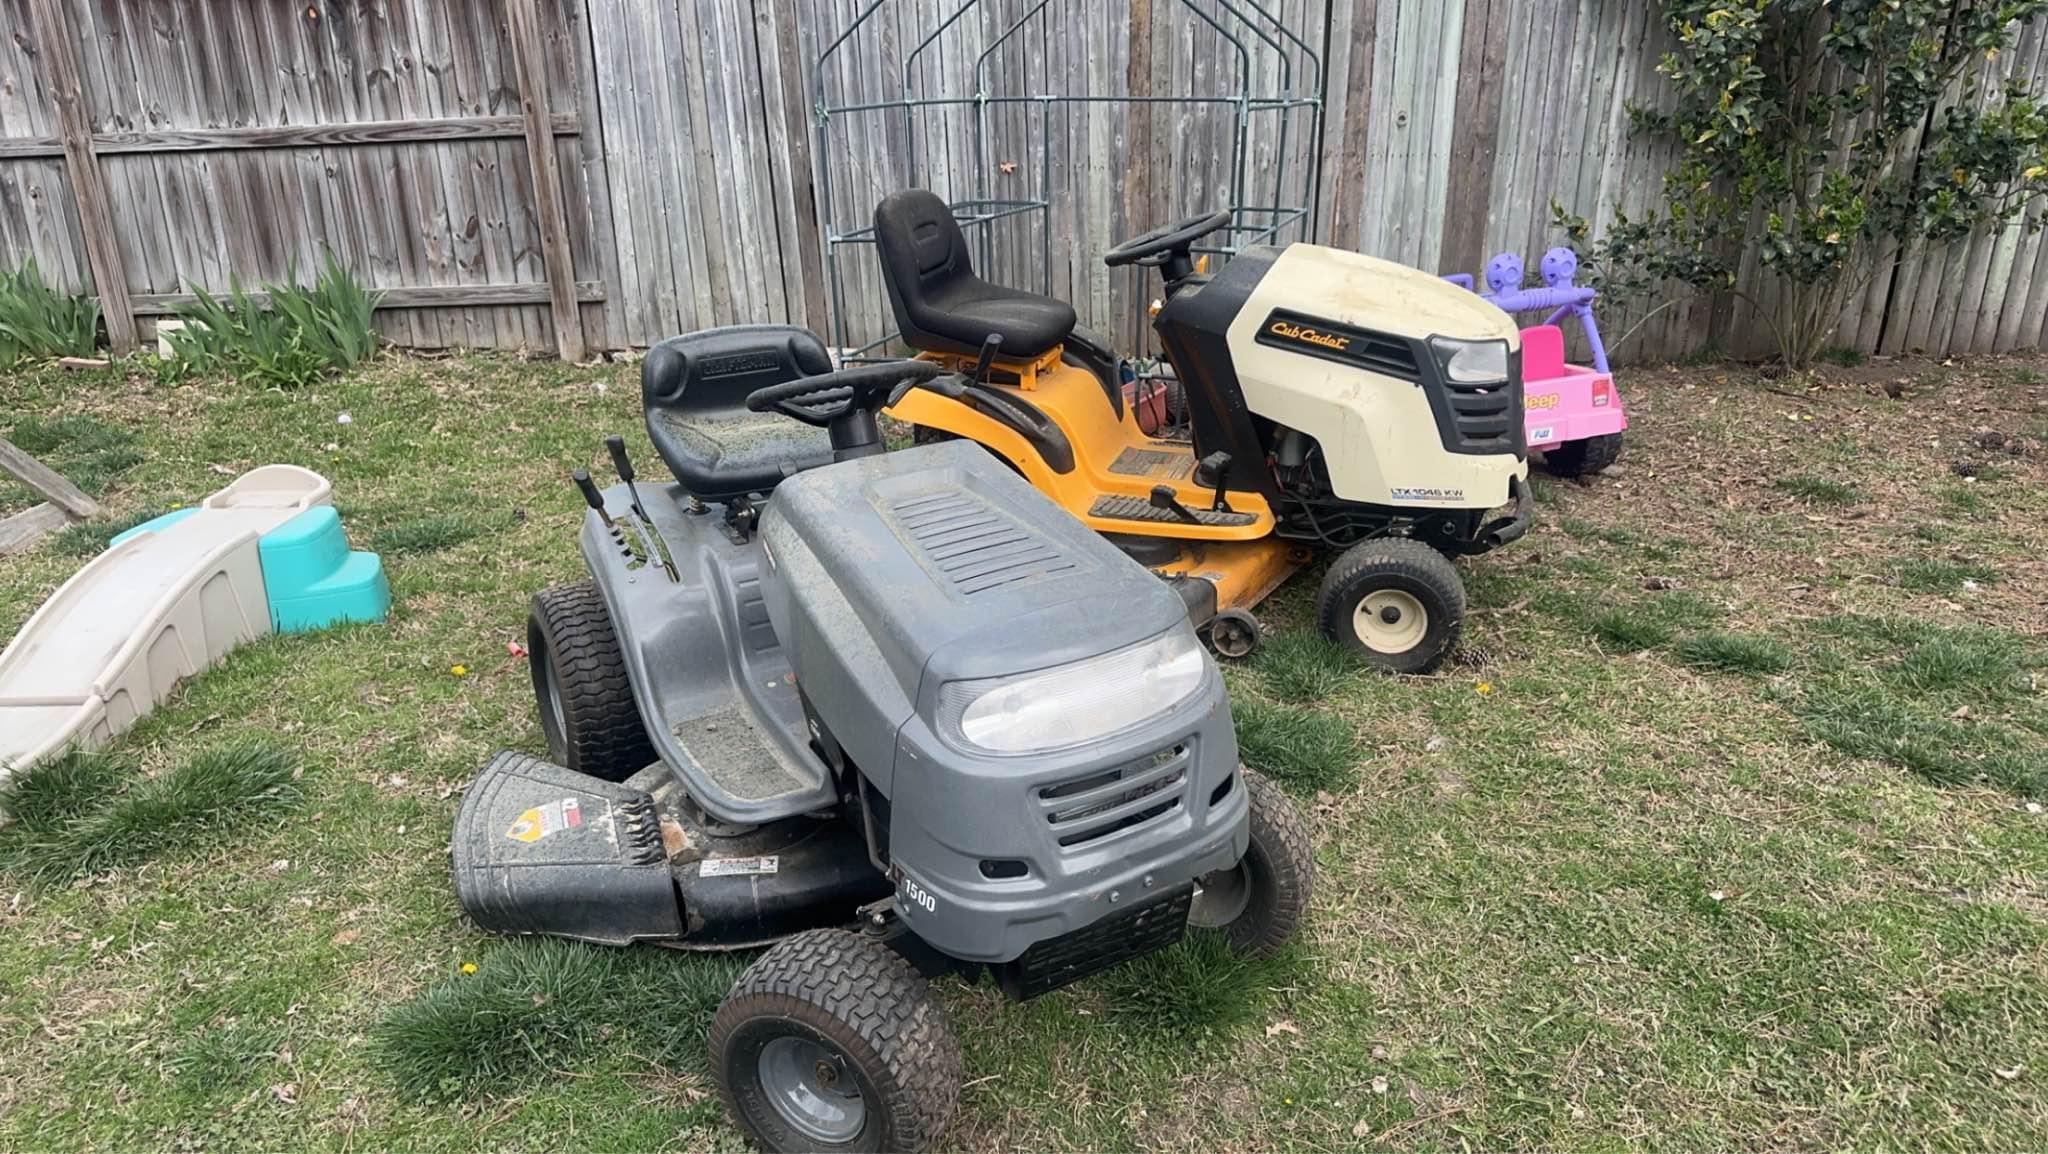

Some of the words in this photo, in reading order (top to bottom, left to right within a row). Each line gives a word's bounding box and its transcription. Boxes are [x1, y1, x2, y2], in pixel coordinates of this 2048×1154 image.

[1271, 322, 1299, 338] Cub
[1300, 329, 1350, 349] Cadet
[905, 879, 936, 912] 1500
